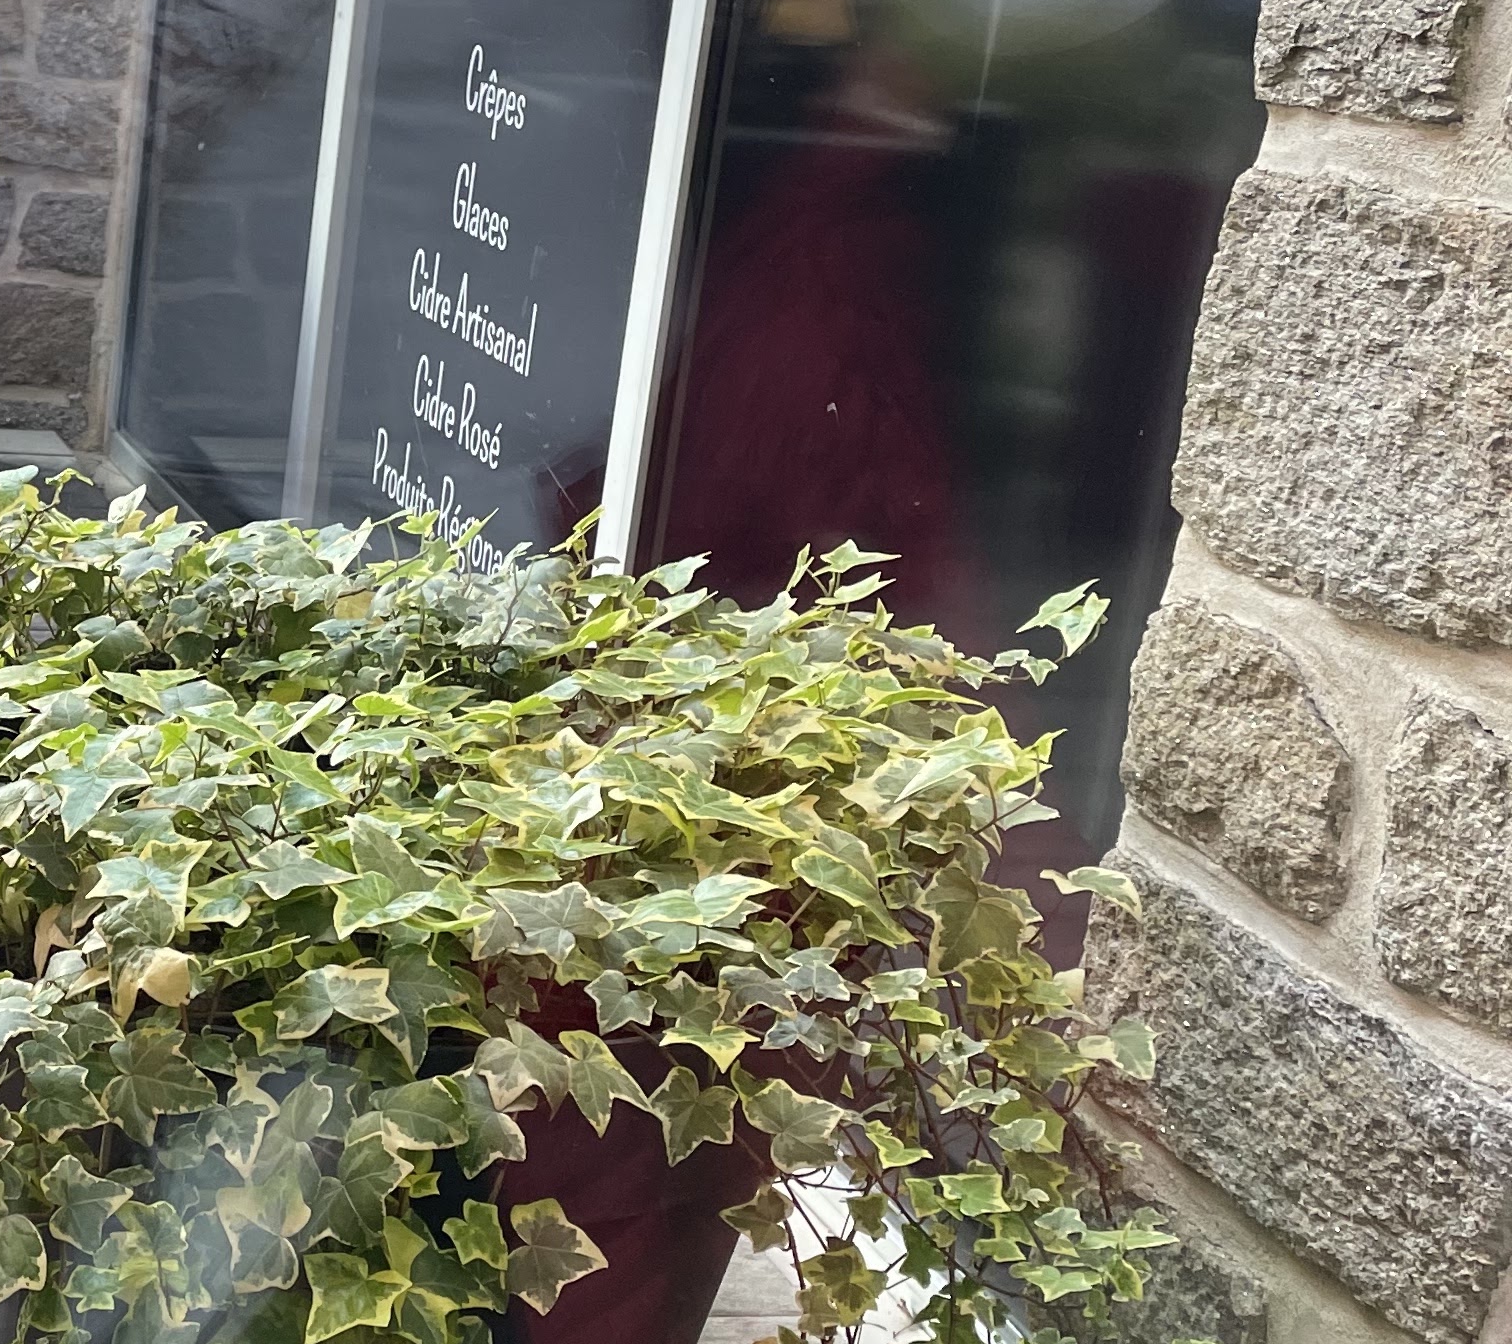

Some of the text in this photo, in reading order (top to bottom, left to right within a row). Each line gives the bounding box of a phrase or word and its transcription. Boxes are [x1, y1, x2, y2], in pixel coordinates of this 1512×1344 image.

[464, 44, 526, 141] Crêpes
[452, 162, 509, 251] Glaces
[409, 248, 538, 377] Cidre Artisanal
[413, 354, 503, 470] Cidre Rosé
